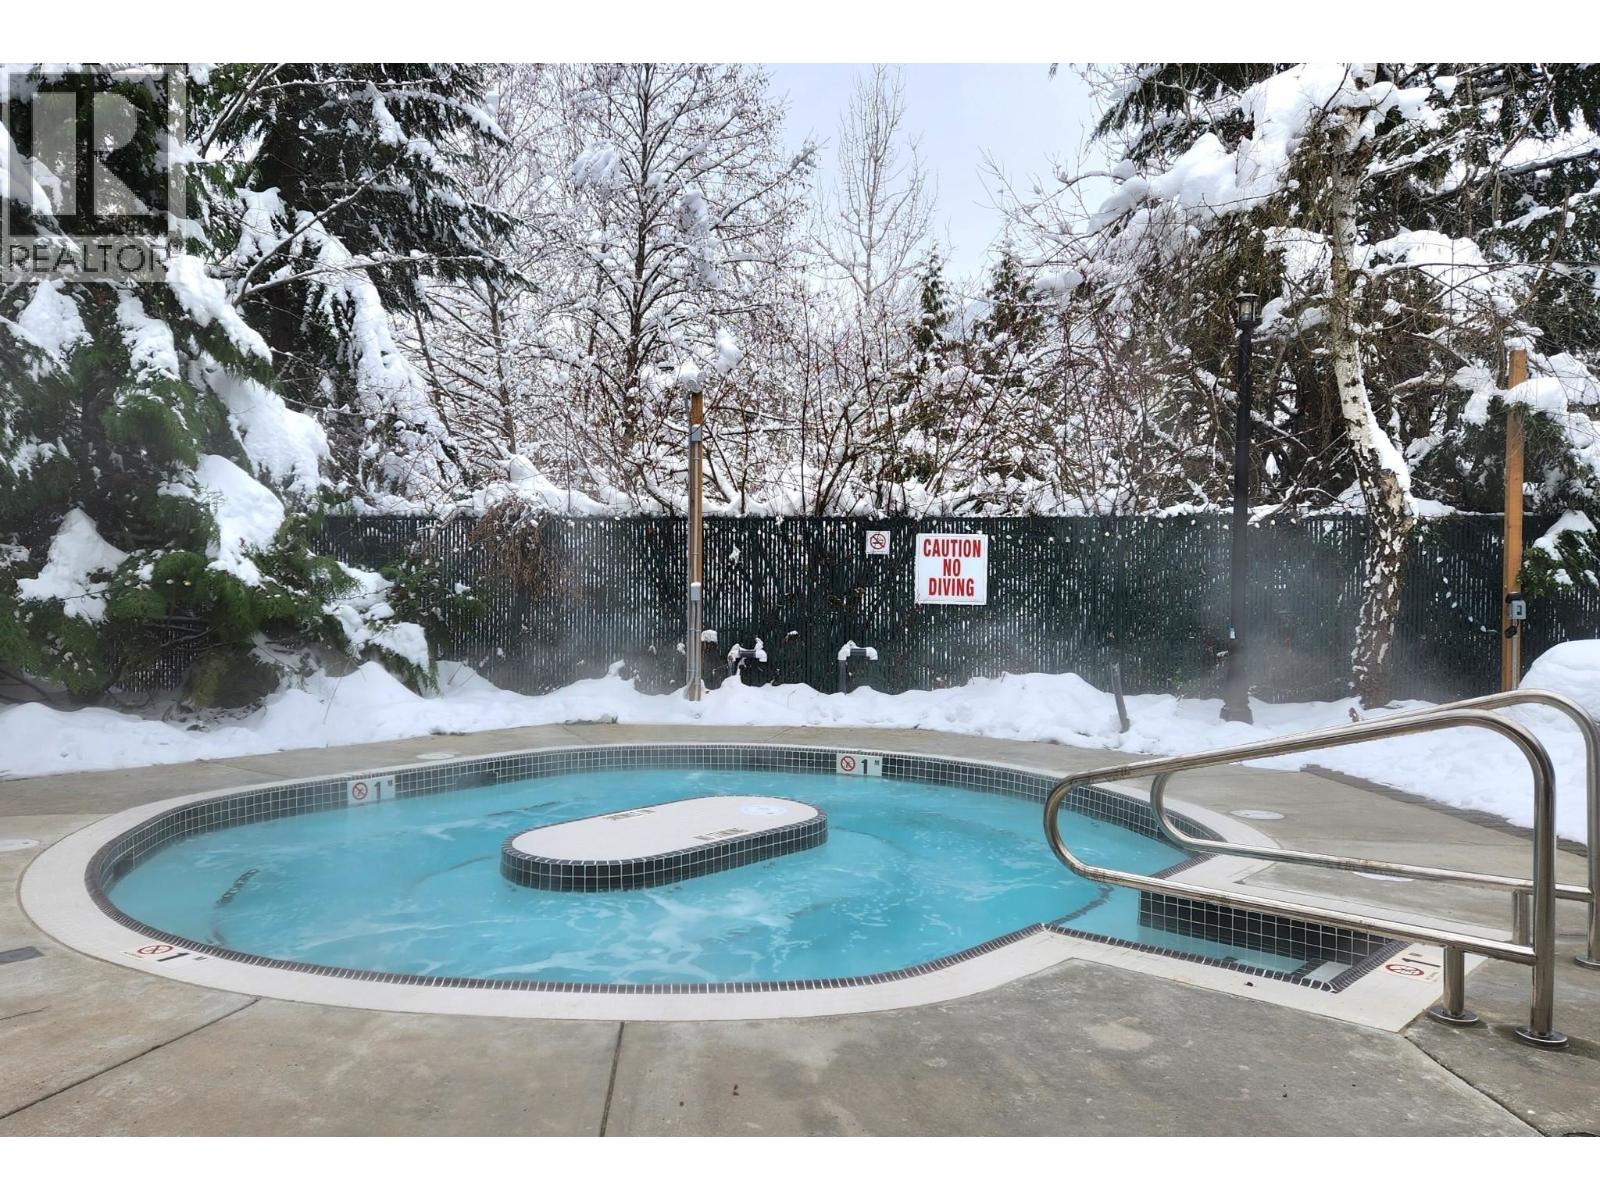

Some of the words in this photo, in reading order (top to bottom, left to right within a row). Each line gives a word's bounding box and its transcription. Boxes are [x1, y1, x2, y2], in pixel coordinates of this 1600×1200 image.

[923, 538, 981, 558] CAUTION
[943, 558, 961, 577] NO
[928, 577, 975, 597] DIVING
[861, 758, 868, 775] 1
[374, 781, 381, 802] 1
